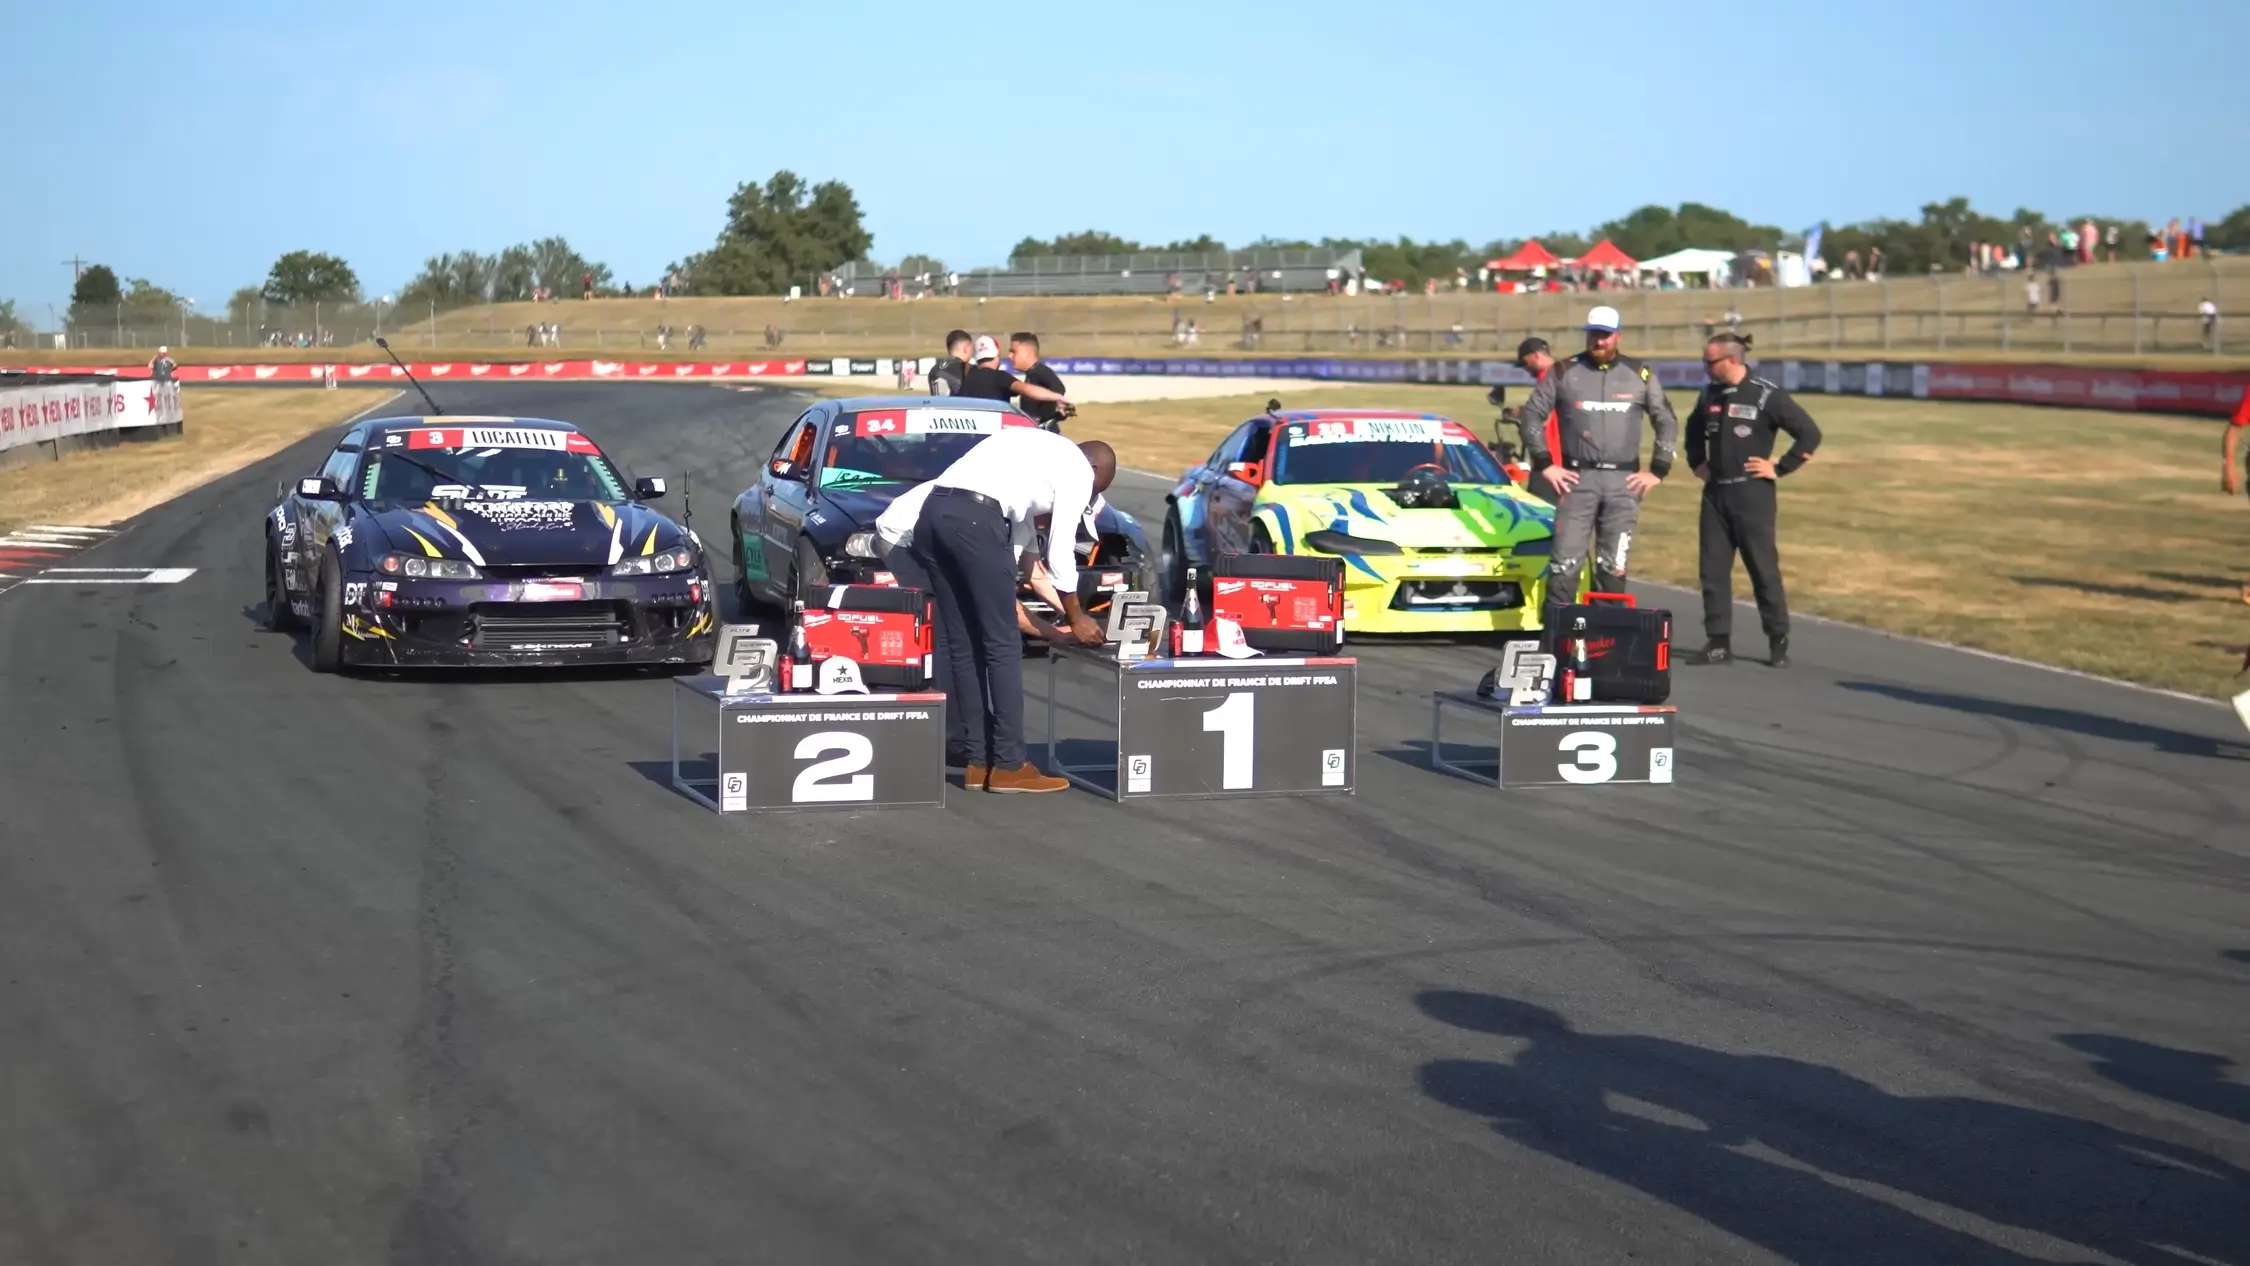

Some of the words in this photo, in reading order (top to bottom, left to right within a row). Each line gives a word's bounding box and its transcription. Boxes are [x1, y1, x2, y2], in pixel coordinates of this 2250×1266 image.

[867, 418, 895, 432] 34
[929, 418, 977, 430] JANIN
[429, 431, 444, 445] 3
[472, 430, 556, 446] LOCATELLI
[832, 676, 853, 684] HEXIS
[1137, 678, 1211, 690] CHAMPIONNAT
[1212, 678, 1227, 688] DE
[1227, 677, 1267, 687] FRANCE
[1268, 677, 1282, 687] DE
[1283, 676, 1312, 686] DRIFT
[1313, 676, 1337, 685] FFSA
[737, 713, 807, 724] CHAMPIONNAT
[808, 713, 823, 722] DE
[823, 712, 862, 722] FRANCE
[862, 712, 876, 721] DE
[877, 712, 904, 721] DRIFT
[905, 711, 929, 720] FFSA
[1511, 718, 1569, 726] CHAMPIONNAT
[1568, 718, 1580, 726] DE
[1580, 717, 1610, 726] FRANCE
[1611, 717, 1622, 725] DE
[1203, 692, 1254, 790] 1
[1557, 731, 1618, 784] 3
[792, 731, 874, 803] 2
